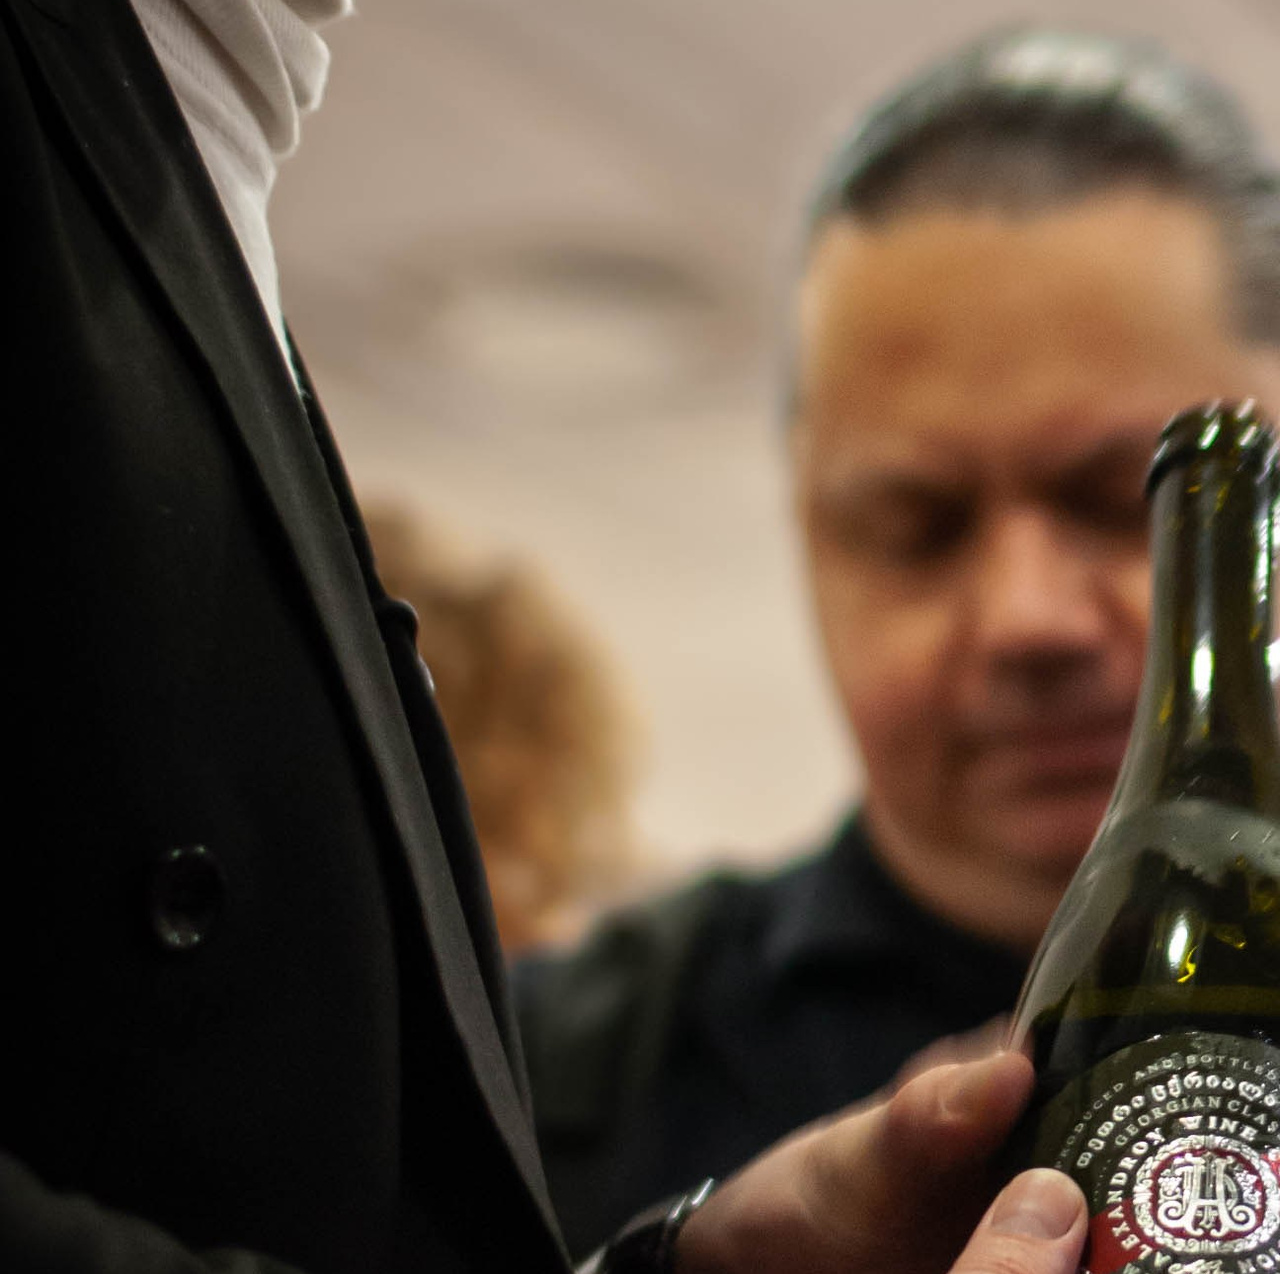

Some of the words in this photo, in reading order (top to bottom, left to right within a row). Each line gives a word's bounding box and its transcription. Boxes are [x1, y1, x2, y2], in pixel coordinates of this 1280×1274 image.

[1134, 1058, 1174, 1081] AND
[1186, 1053, 1279, 1081] BOTTLED
[1115, 1095, 1222, 1146] GEORGIAN
[1179, 1115, 1259, 1141] WINE
